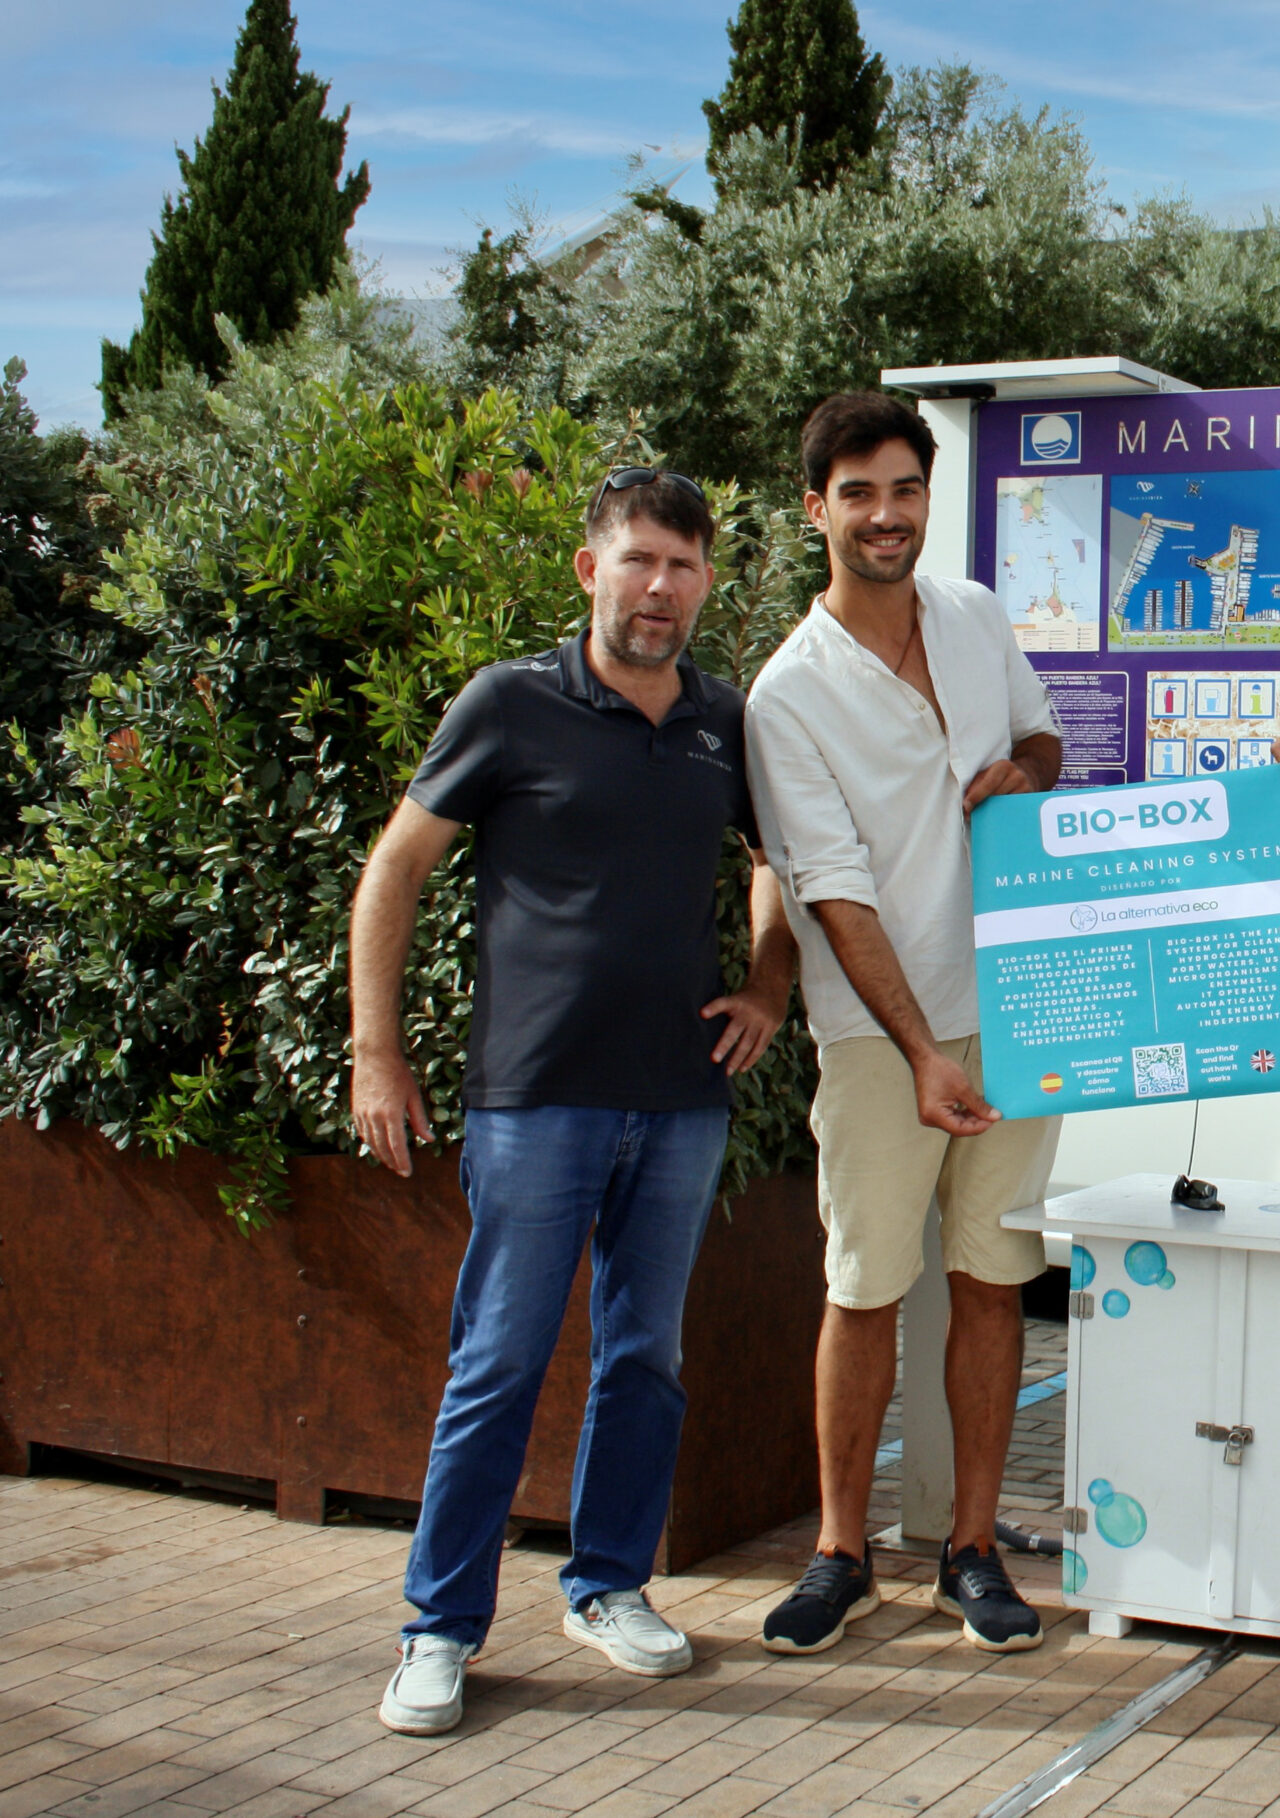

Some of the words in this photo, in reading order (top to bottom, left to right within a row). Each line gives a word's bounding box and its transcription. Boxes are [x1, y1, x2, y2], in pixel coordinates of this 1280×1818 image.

[1056, 796, 1214, 839] BIO-BOX
[995, 868, 1075, 888] MARINE
[1088, 854, 1195, 877] CLEANING
[1160, 876, 1182, 885] POR
[1101, 910, 1116, 922] La
[1118, 903, 1190, 920] alternativa
[1192, 900, 1219, 912] eco
[1167, 934, 1218, 946] BIO-BOX
[1241, 929, 1262, 938] THE
[1091, 944, 1133, 954] PRIMER
[1166, 944, 1211, 956] SYSTEM
[1217, 941, 1238, 950] FOR
[1179, 947, 1274, 964] HYDROCARBONS
[1001, 962, 1051, 974] SISTEMA
[1057, 960, 1071, 968] DE
[1076, 953, 1131, 965] LIMPIEZA
[1172, 964, 1202, 974] PORT
[998, 976, 1011, 984] DE
[1122, 962, 1136, 970] DE
[1035, 981, 1055, 989] LAS
[1061, 975, 1100, 986] AGUAS
[1004, 987, 1079, 1002] PORTUARIAS
[1085, 981, 1132, 993] BASADO
[1201, 991, 1212, 999] IT
[1218, 984, 1277, 997] OPERATES
[1000, 1003, 1014, 1012] EN
[1177, 994, 1274, 1011] AUTOMATICALLY
[1227, 1003, 1272, 1014] ENERGY
[1014, 1021, 1027, 1029] ES
[1203, 1056, 1218, 1064] and
[1219, 1054, 1234, 1062] find
[1083, 1066, 1119, 1076] descubre
[1201, 1066, 1214, 1074] out
[1214, 1065, 1230, 1073] how
[1208, 1075, 1231, 1083] works
[1081, 1086, 1116, 1096] funciona
